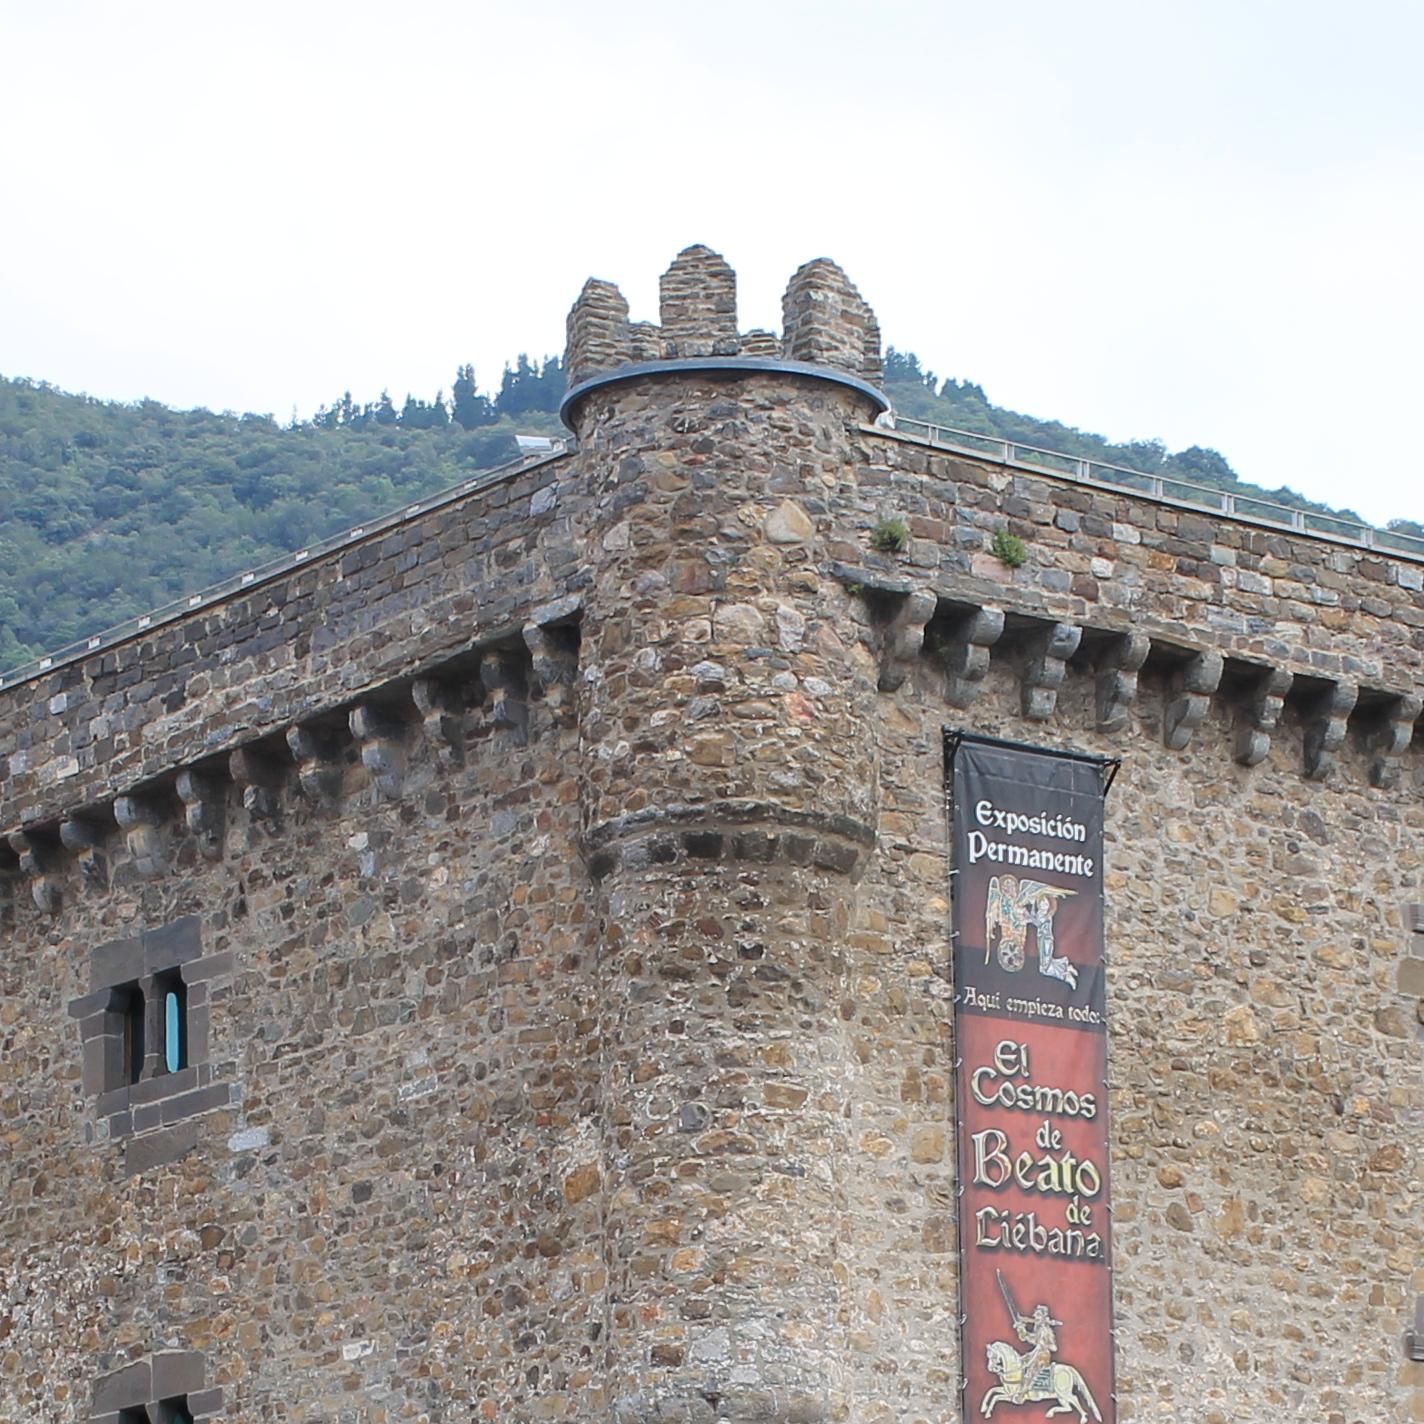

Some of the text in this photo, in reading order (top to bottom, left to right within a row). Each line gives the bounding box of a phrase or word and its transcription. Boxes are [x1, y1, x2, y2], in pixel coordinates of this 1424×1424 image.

[975, 800, 1086, 841] Exposición
[967, 830, 1094, 877] Permanente
[1006, 997, 1064, 1018] empieza
[994, 1040, 1030, 1077] El
[971, 1066, 1097, 1118] Cosmos
[1036, 1120, 1062, 1150] de
[972, 1129, 1101, 1197] Beato
[1065, 1196, 1092, 1225] de
